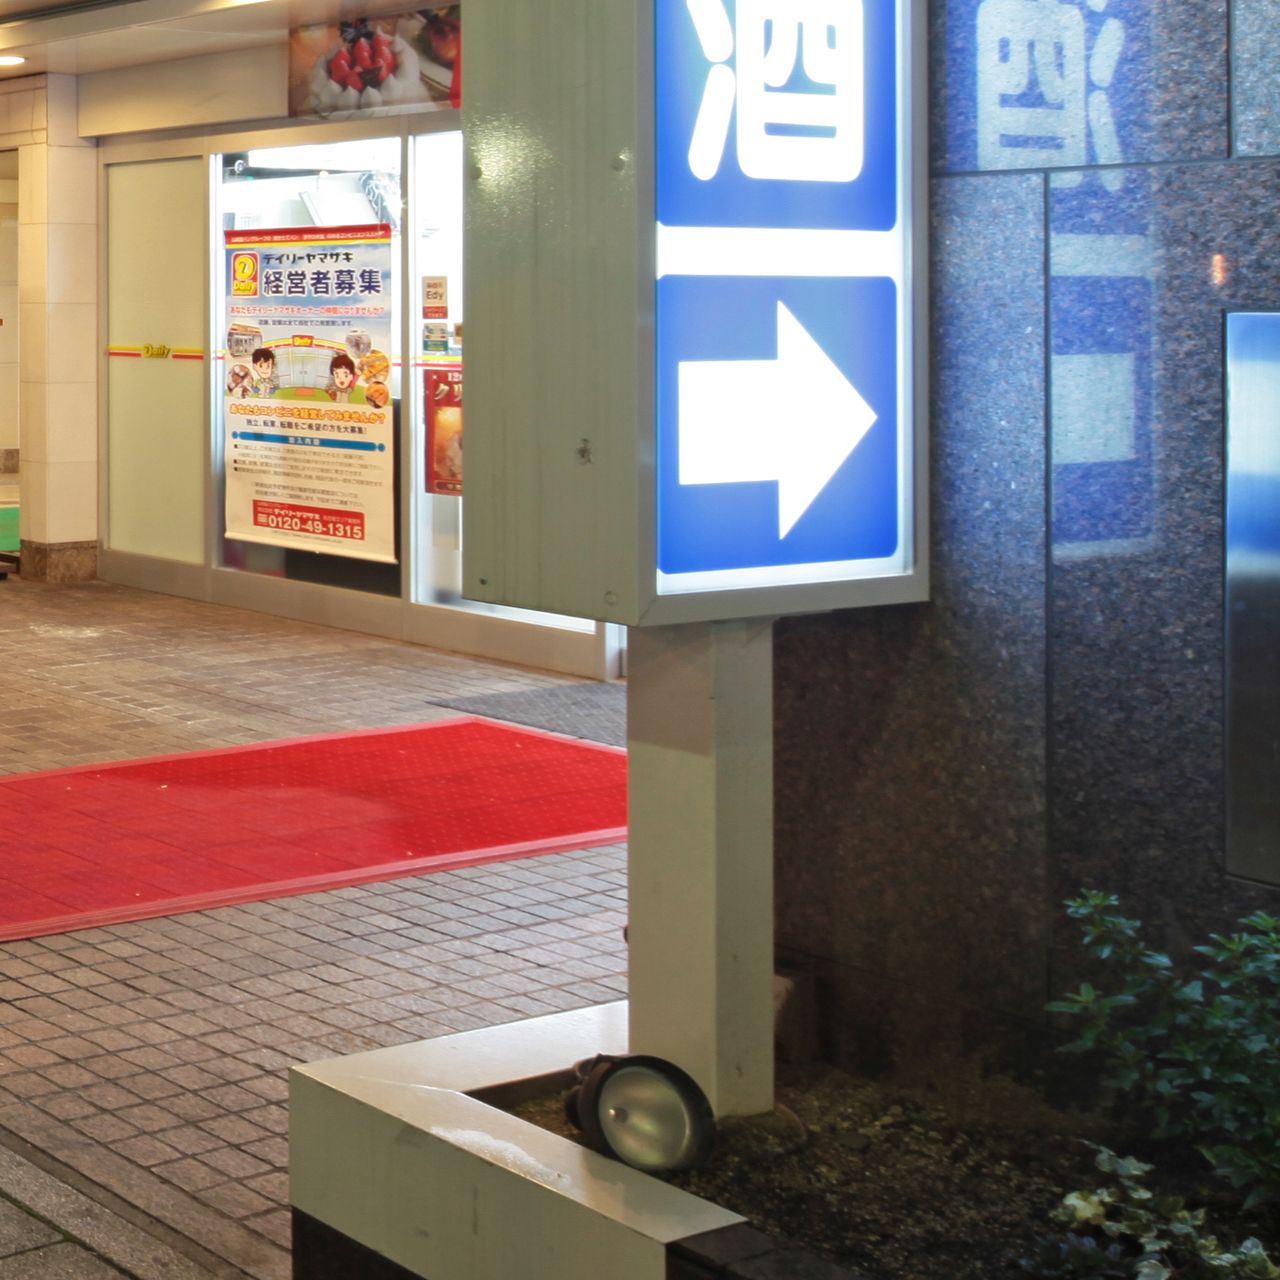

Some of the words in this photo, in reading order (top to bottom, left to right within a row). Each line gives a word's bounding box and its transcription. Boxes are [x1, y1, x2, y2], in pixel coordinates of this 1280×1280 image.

[263, 252, 354, 265] デイリーヤマザキ
[233, 279, 256, 293] Daily
[263, 269, 381, 295] 経営者募集
[426, 290, 444, 302] Edy
[144, 343, 172, 359] Daily
[268, 515, 363, 539] 0120-49-1315
